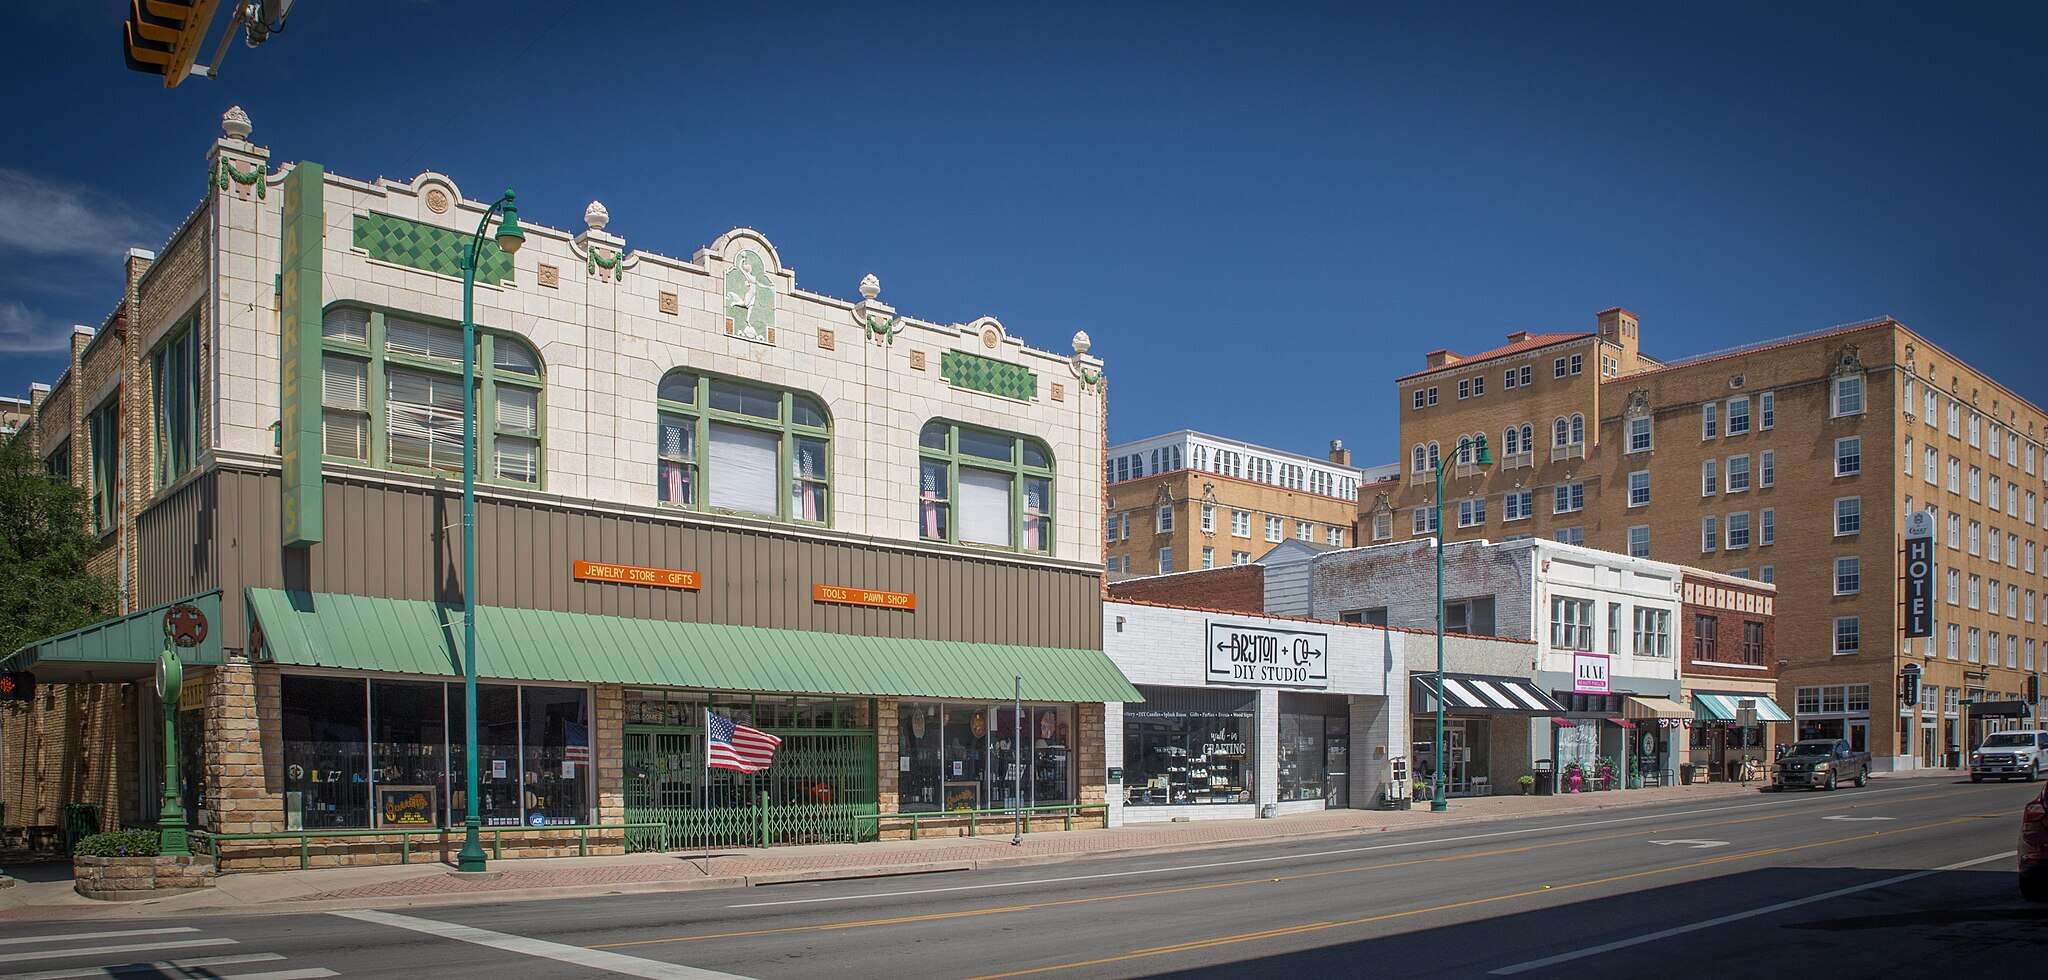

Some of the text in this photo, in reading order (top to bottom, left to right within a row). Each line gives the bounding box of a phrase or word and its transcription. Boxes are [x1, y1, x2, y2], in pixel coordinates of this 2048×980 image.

[585, 564, 693, 585] JEWELRY STORE GIFTS
[822, 588, 908, 605] TOOLS PAWN SHOP
[1909, 542, 1928, 634] HOTEL
[1233, 664, 1307, 682] DIY STUDIO
[1579, 664, 1605, 679] LUXE
[1202, 742, 1246, 755] CRAFTING
